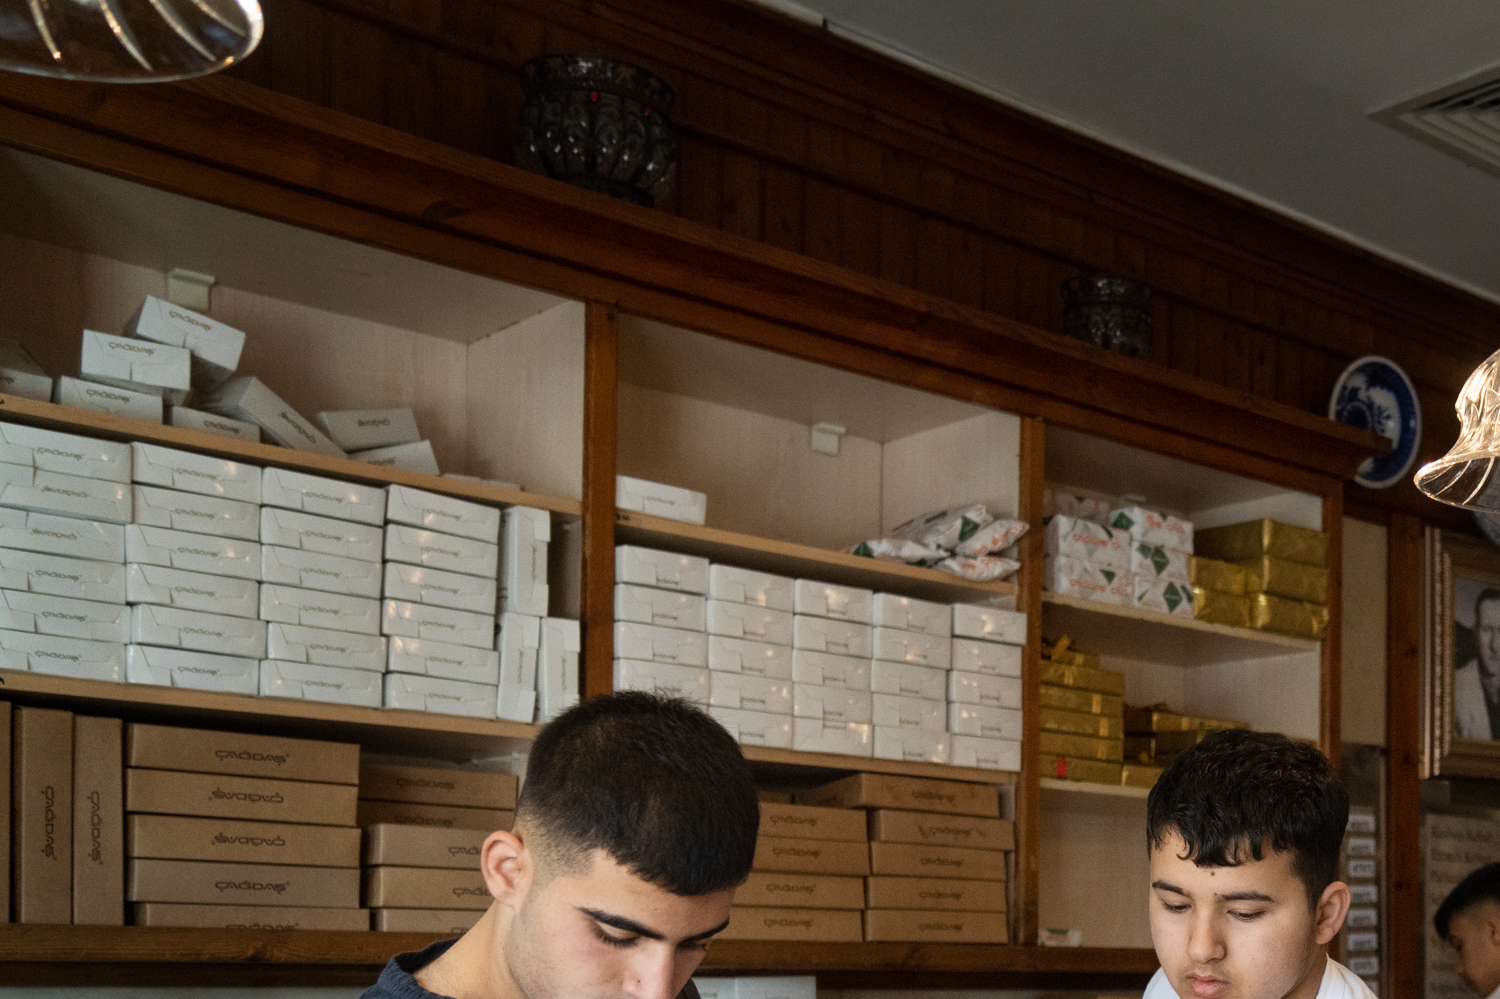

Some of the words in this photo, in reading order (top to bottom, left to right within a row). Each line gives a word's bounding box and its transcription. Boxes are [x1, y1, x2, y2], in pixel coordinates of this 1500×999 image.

[215, 750, 286, 766] ÇAĞDAŞ
[212, 788, 284, 803] ÇAĞDAŞ
[41, 786, 57, 858] ÇAĞDAŞ
[87, 791, 103, 862] ÇAĞDAŞ
[215, 833, 285, 847] ÇAĞDAŞ
[215, 881, 286, 894] ÇAĞDAŞ
